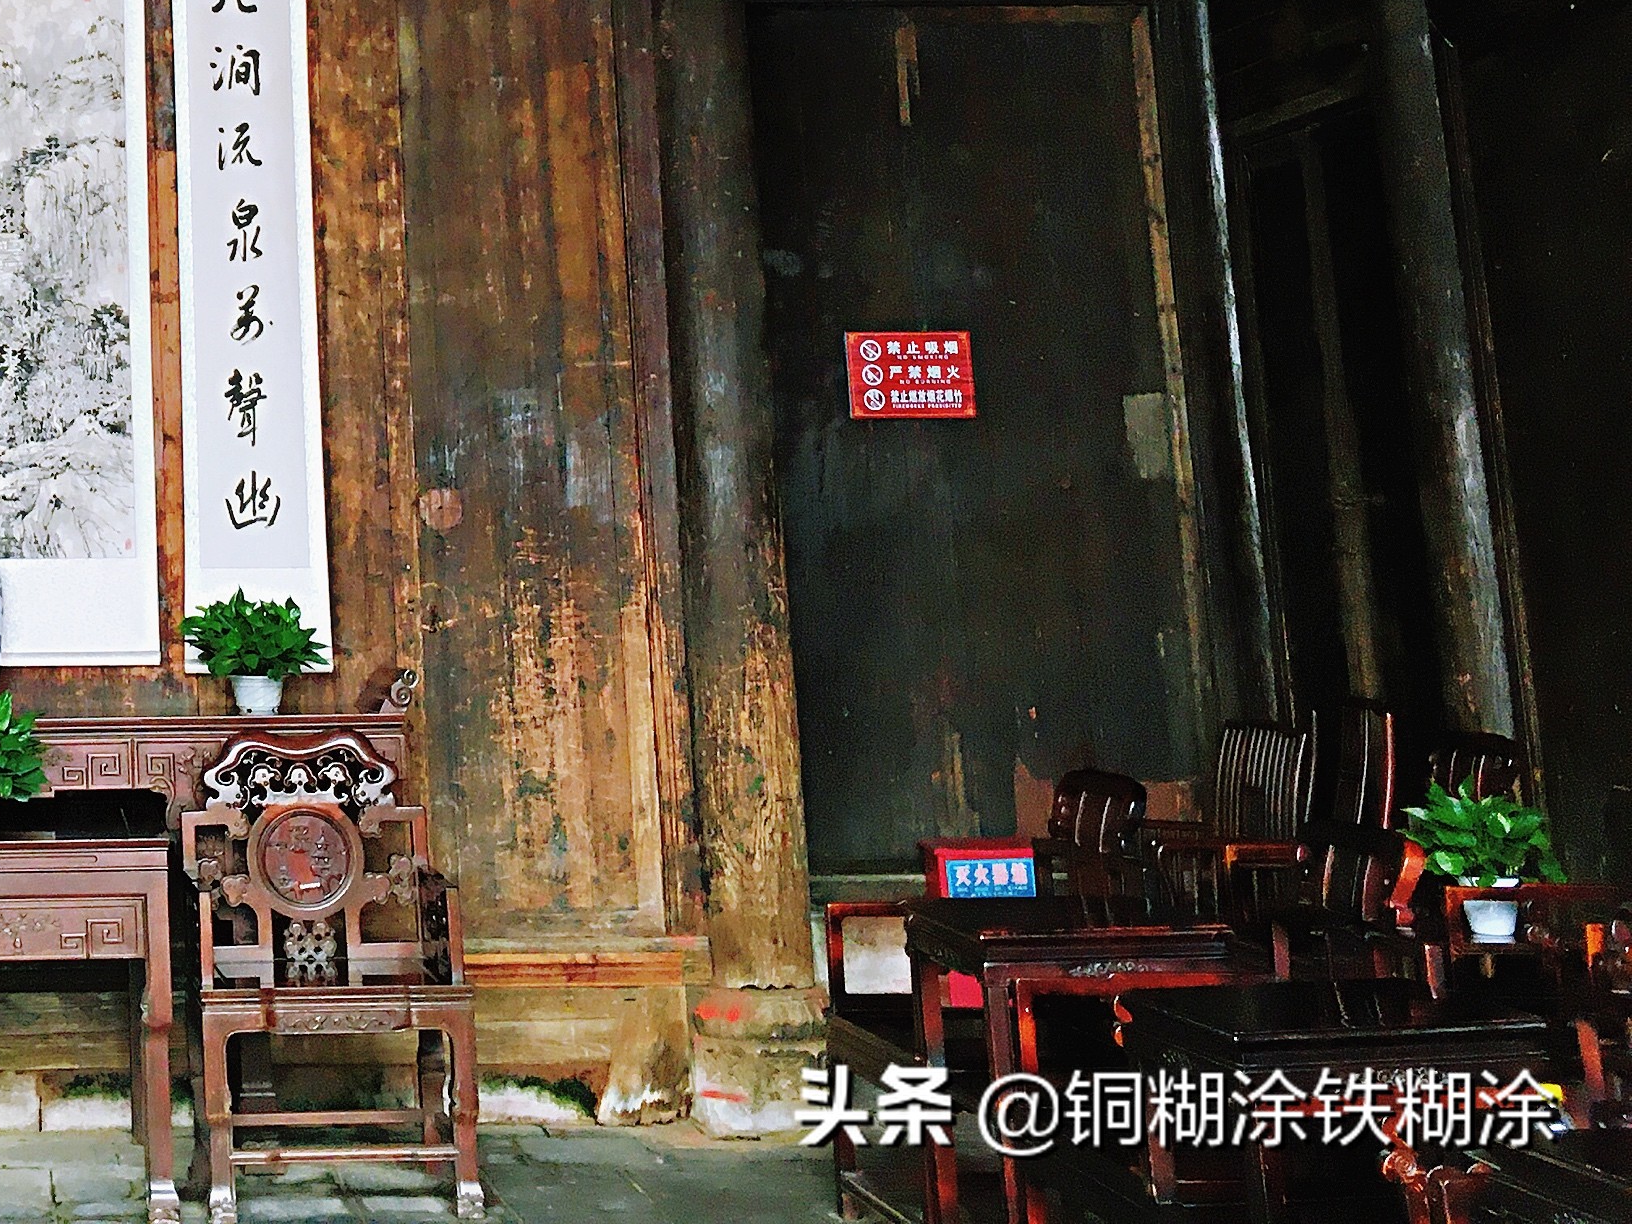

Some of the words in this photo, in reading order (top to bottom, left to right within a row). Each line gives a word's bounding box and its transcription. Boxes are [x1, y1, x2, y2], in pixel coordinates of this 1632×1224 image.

[886, 340, 959, 355] 禁止吸烟
[889, 365, 961, 380] 严禁烟火
